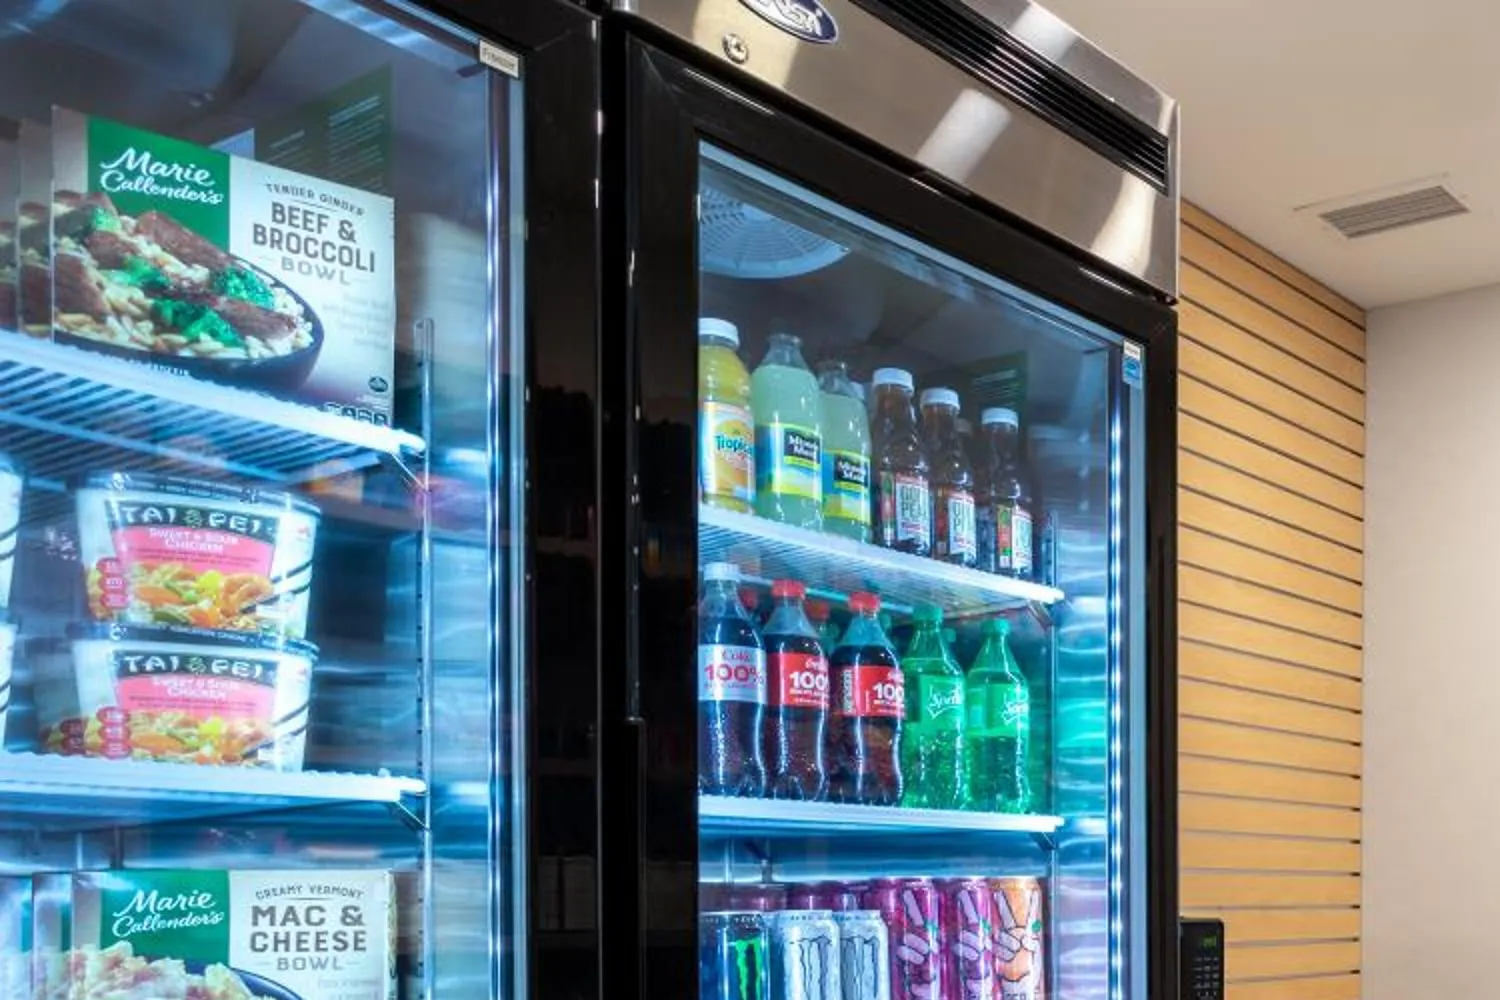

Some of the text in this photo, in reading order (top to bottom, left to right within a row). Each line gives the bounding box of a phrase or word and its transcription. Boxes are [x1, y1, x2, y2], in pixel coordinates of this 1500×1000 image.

[99, 147, 216, 187] Marie
[100, 169, 225, 205] Callender's
[271, 201, 356, 243] BEEF &
[252, 222, 375, 273] BROCCOLI
[281, 256, 351, 286] BOWL
[121, 506, 262, 532] TAI PEI
[124, 655, 264, 679] TAI PEI
[112, 889, 216, 917] Marie
[255, 883, 364, 900] CREAMY VERMONT
[112, 911, 224, 938] Callender's
[251, 905, 365, 927] MAC &
[250, 931, 367, 953] CHEESE
[277, 956, 343, 971] BOWL
